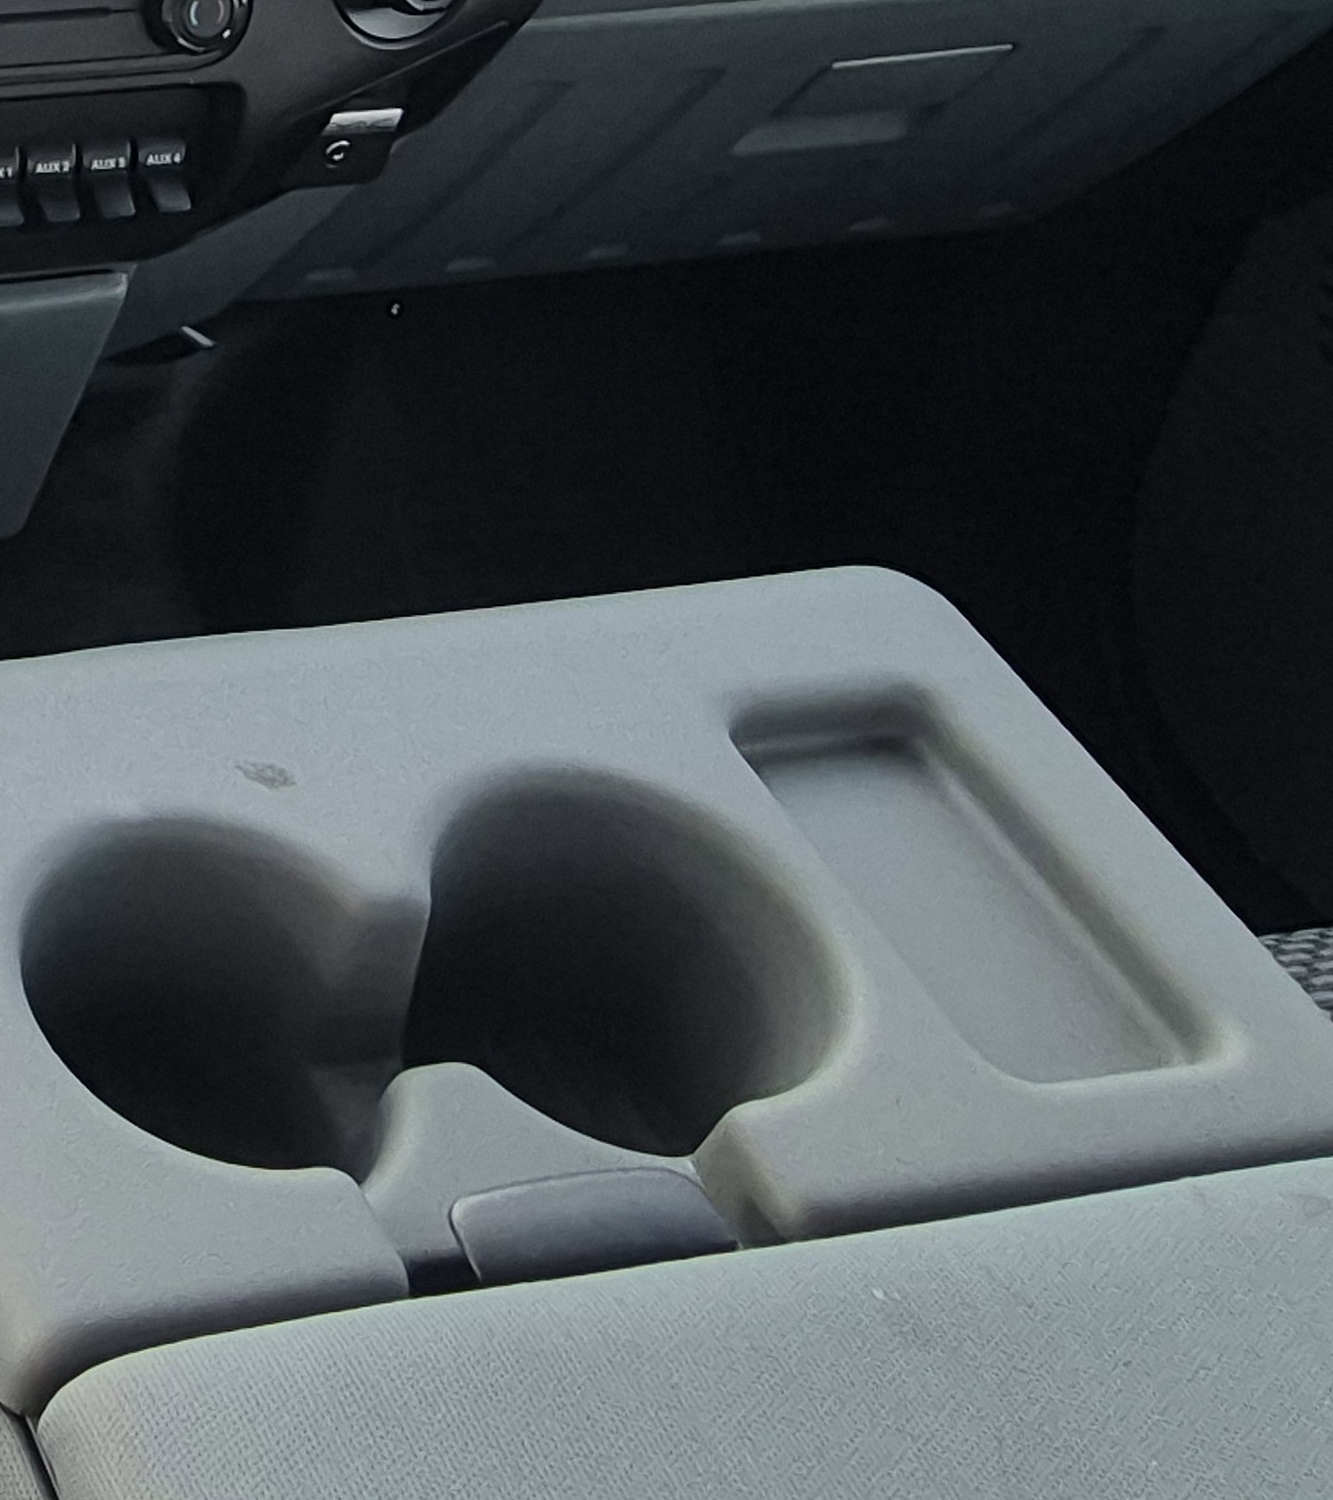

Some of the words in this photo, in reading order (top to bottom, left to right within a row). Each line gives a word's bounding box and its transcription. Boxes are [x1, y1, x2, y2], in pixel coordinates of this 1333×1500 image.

[91, 159, 115, 171] AUX
[146, 154, 170, 166] AUX
[36, 162, 60, 173] AUX
